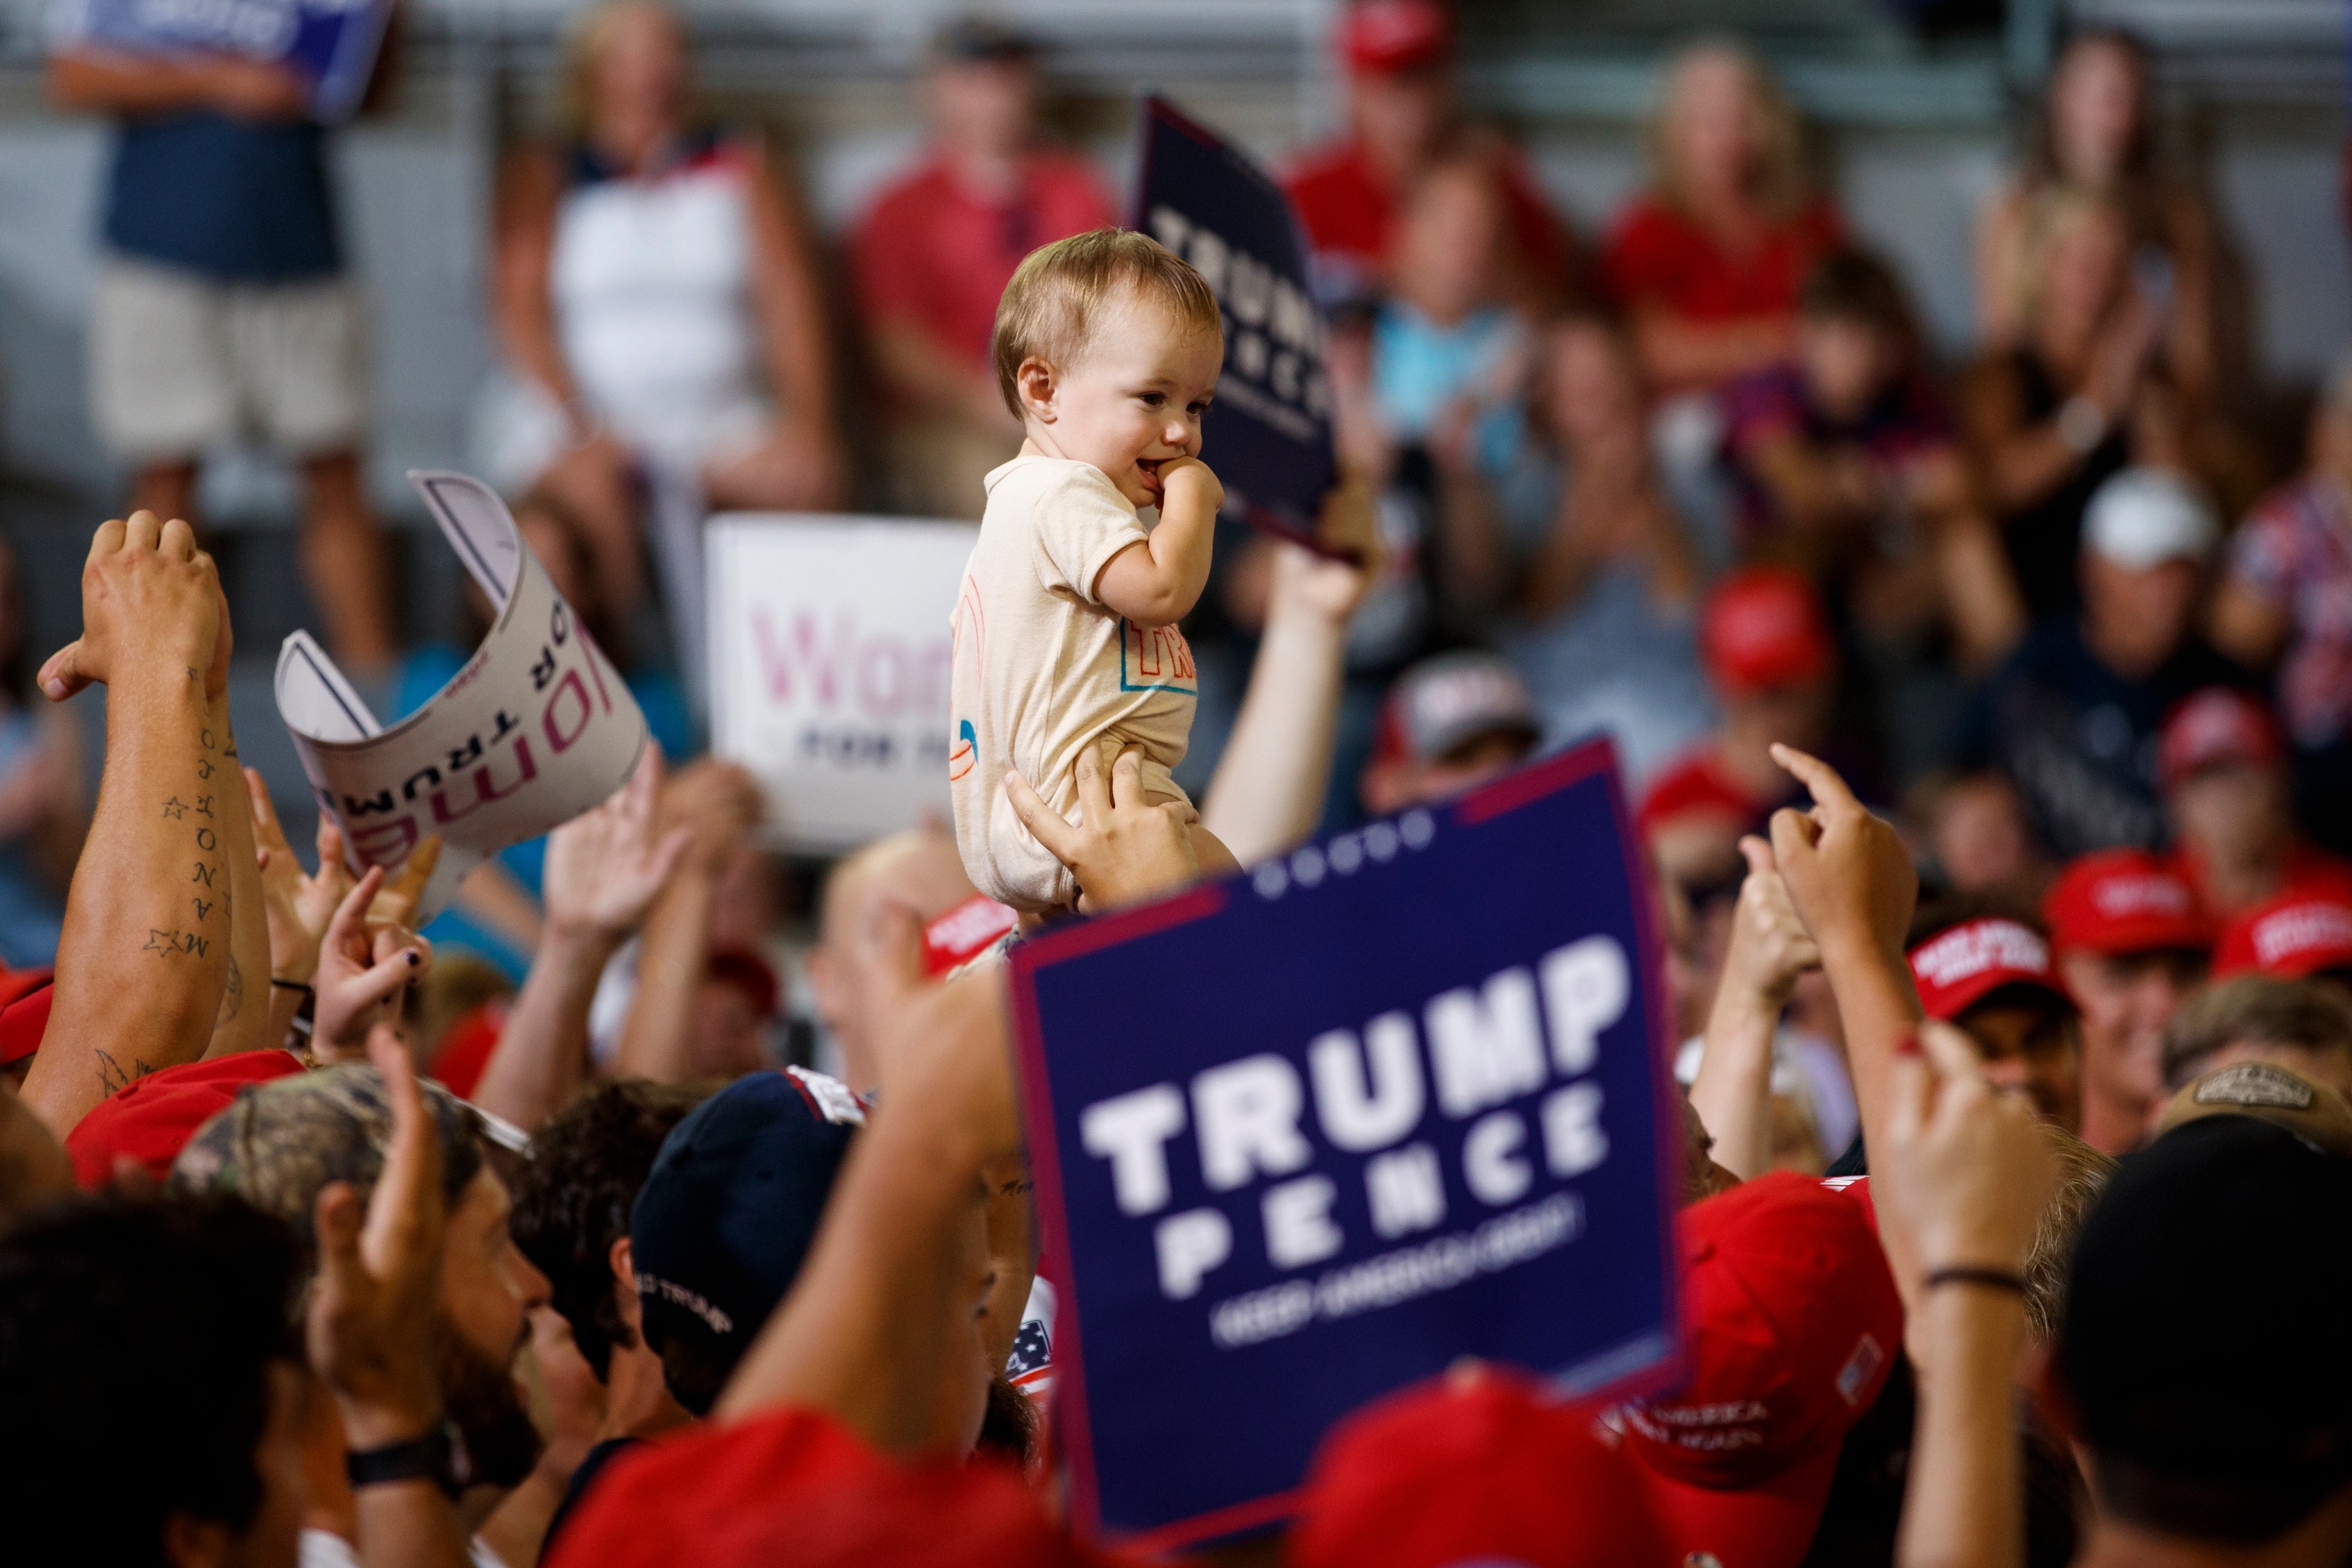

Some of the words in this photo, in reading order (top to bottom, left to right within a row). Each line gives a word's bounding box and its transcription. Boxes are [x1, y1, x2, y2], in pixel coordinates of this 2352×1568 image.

[1129, 621, 1196, 679] TR
[1080, 934, 1629, 1216] TRUMP
[1154, 1081, 1609, 1300] PENCE
[658, 1279, 734, 1334] TRUMP
